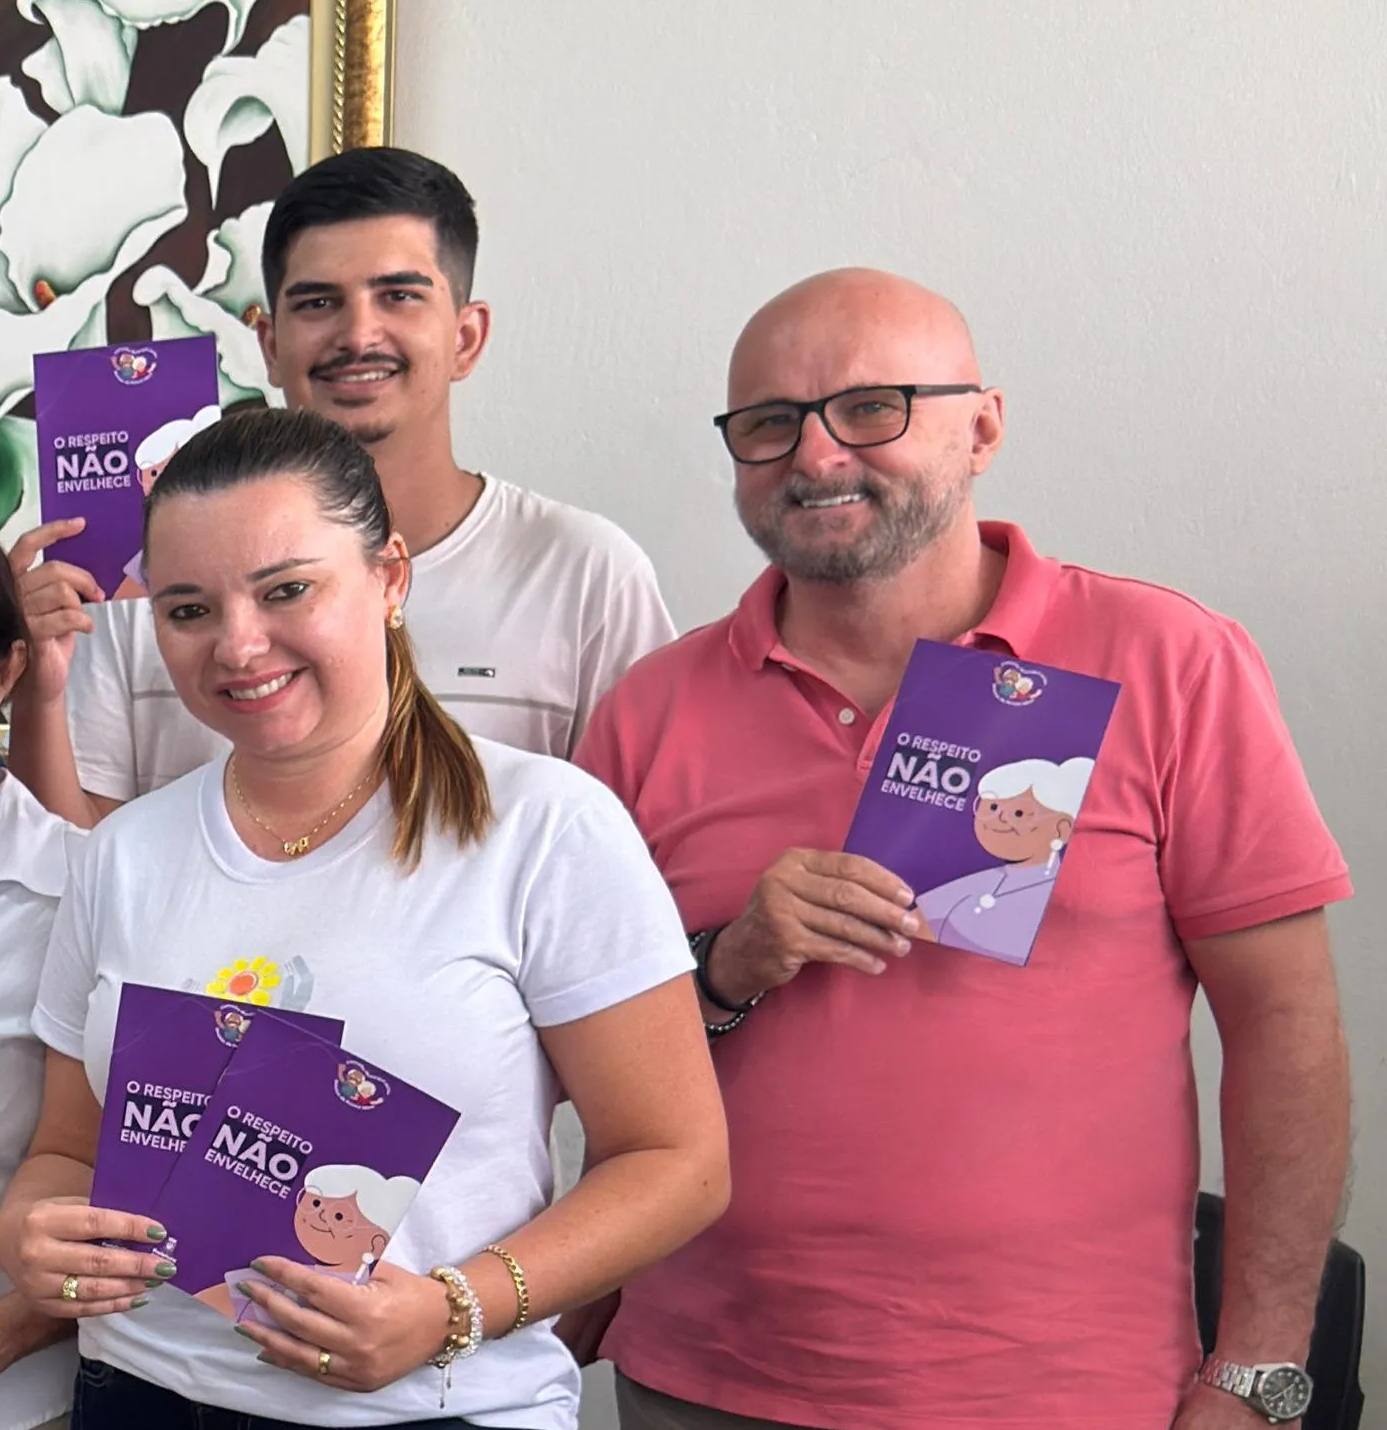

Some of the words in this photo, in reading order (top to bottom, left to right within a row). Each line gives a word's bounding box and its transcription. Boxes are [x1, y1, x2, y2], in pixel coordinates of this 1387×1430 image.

[54, 437, 65, 449] O
[68, 431, 129, 448] RESPEITO
[57, 444, 128, 479] NÃO
[57, 476, 131, 494] ENVELHECE
[897, 733, 911, 746] O
[911, 736, 981, 763] RESPEITO
[887, 751, 971, 795] NÃO
[880, 780, 967, 812] ENVELHECE
[127, 1080, 140, 1094] O
[227, 1105, 241, 1119] O
[243, 1112, 313, 1154] RESPEITO
[212, 1124, 299, 1181] NÃO
[204, 1149, 291, 1199] ENVELHECE
